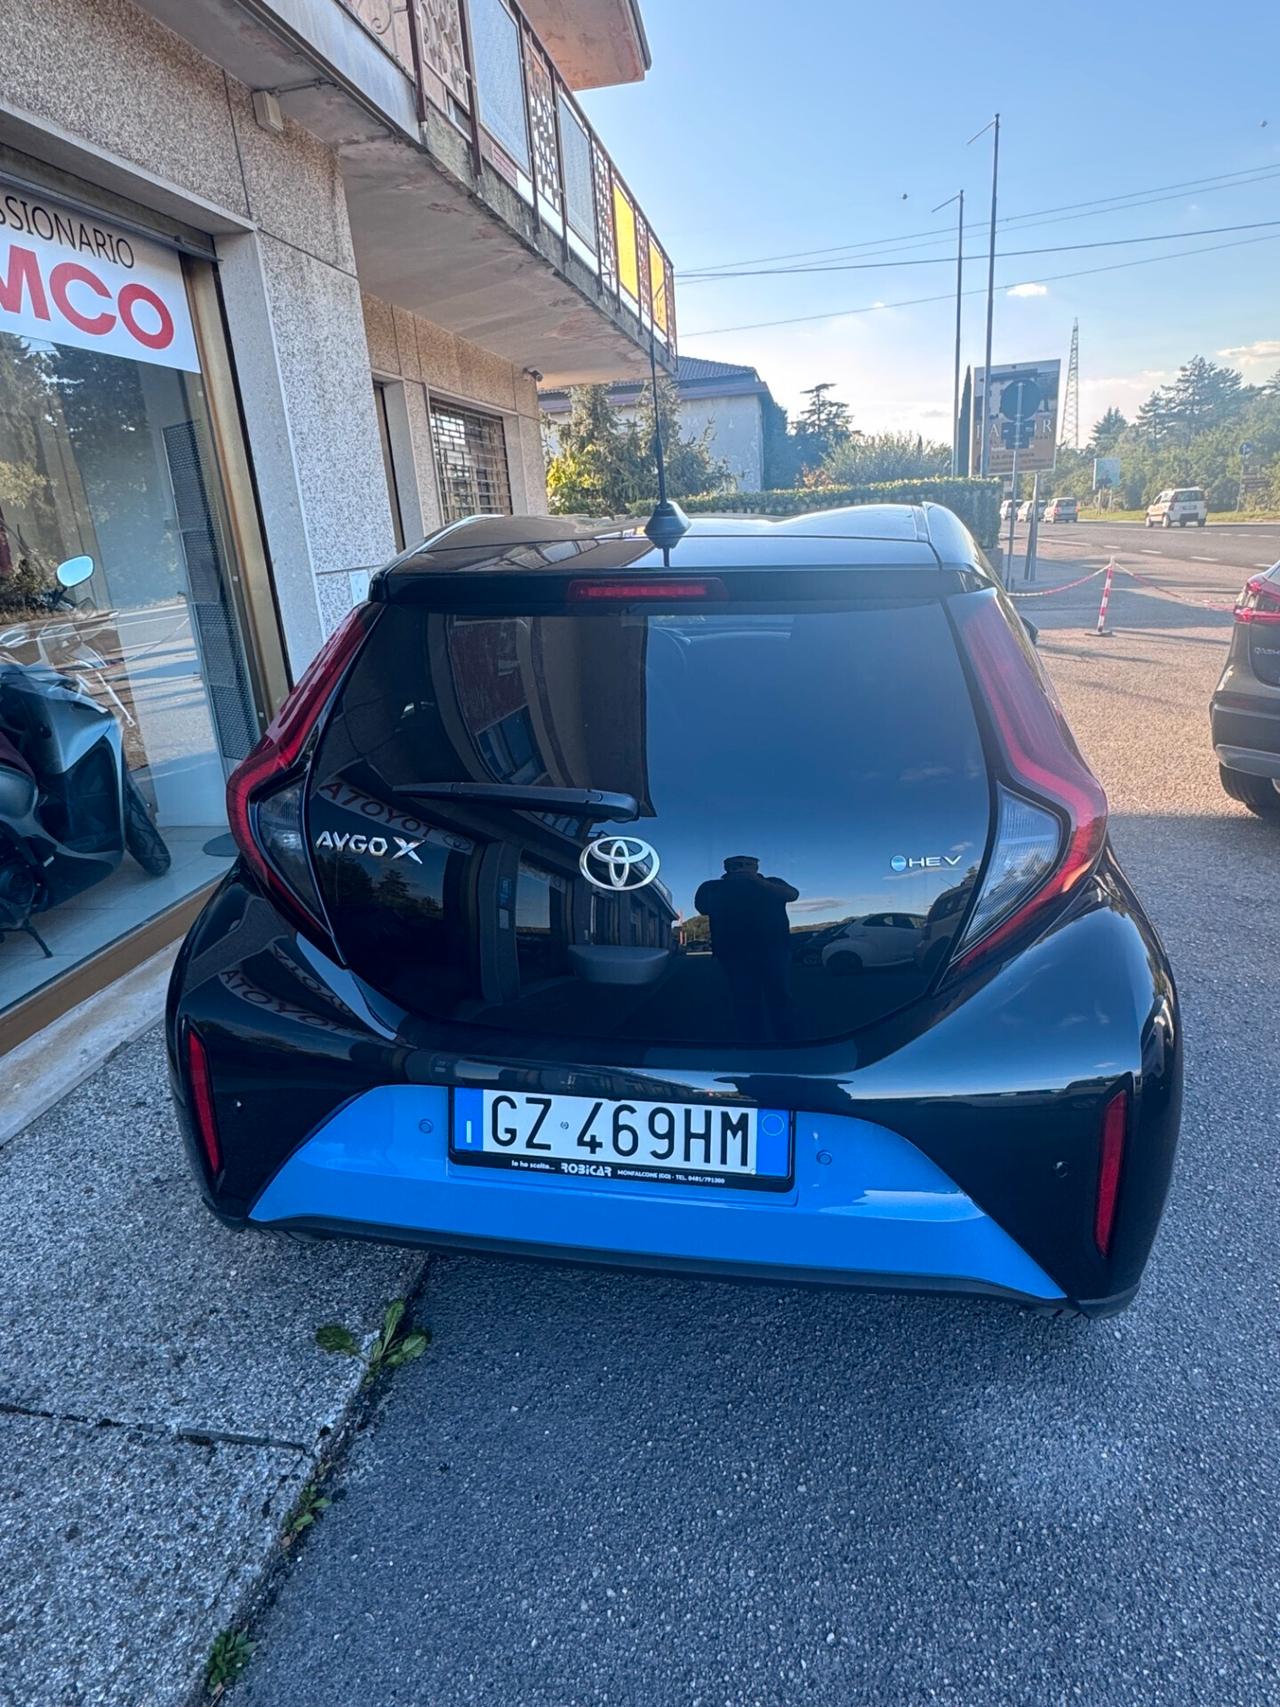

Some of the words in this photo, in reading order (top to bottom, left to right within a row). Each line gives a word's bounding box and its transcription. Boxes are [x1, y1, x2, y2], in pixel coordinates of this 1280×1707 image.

[0, 195, 135, 269] SIONARIO
[315, 830, 389, 857] AYGO
[391, 835, 426, 865] X
[908, 855, 962, 868] HEV
[491, 1095, 552, 1151] GZ
[576, 1101, 750, 1167] 469HM
